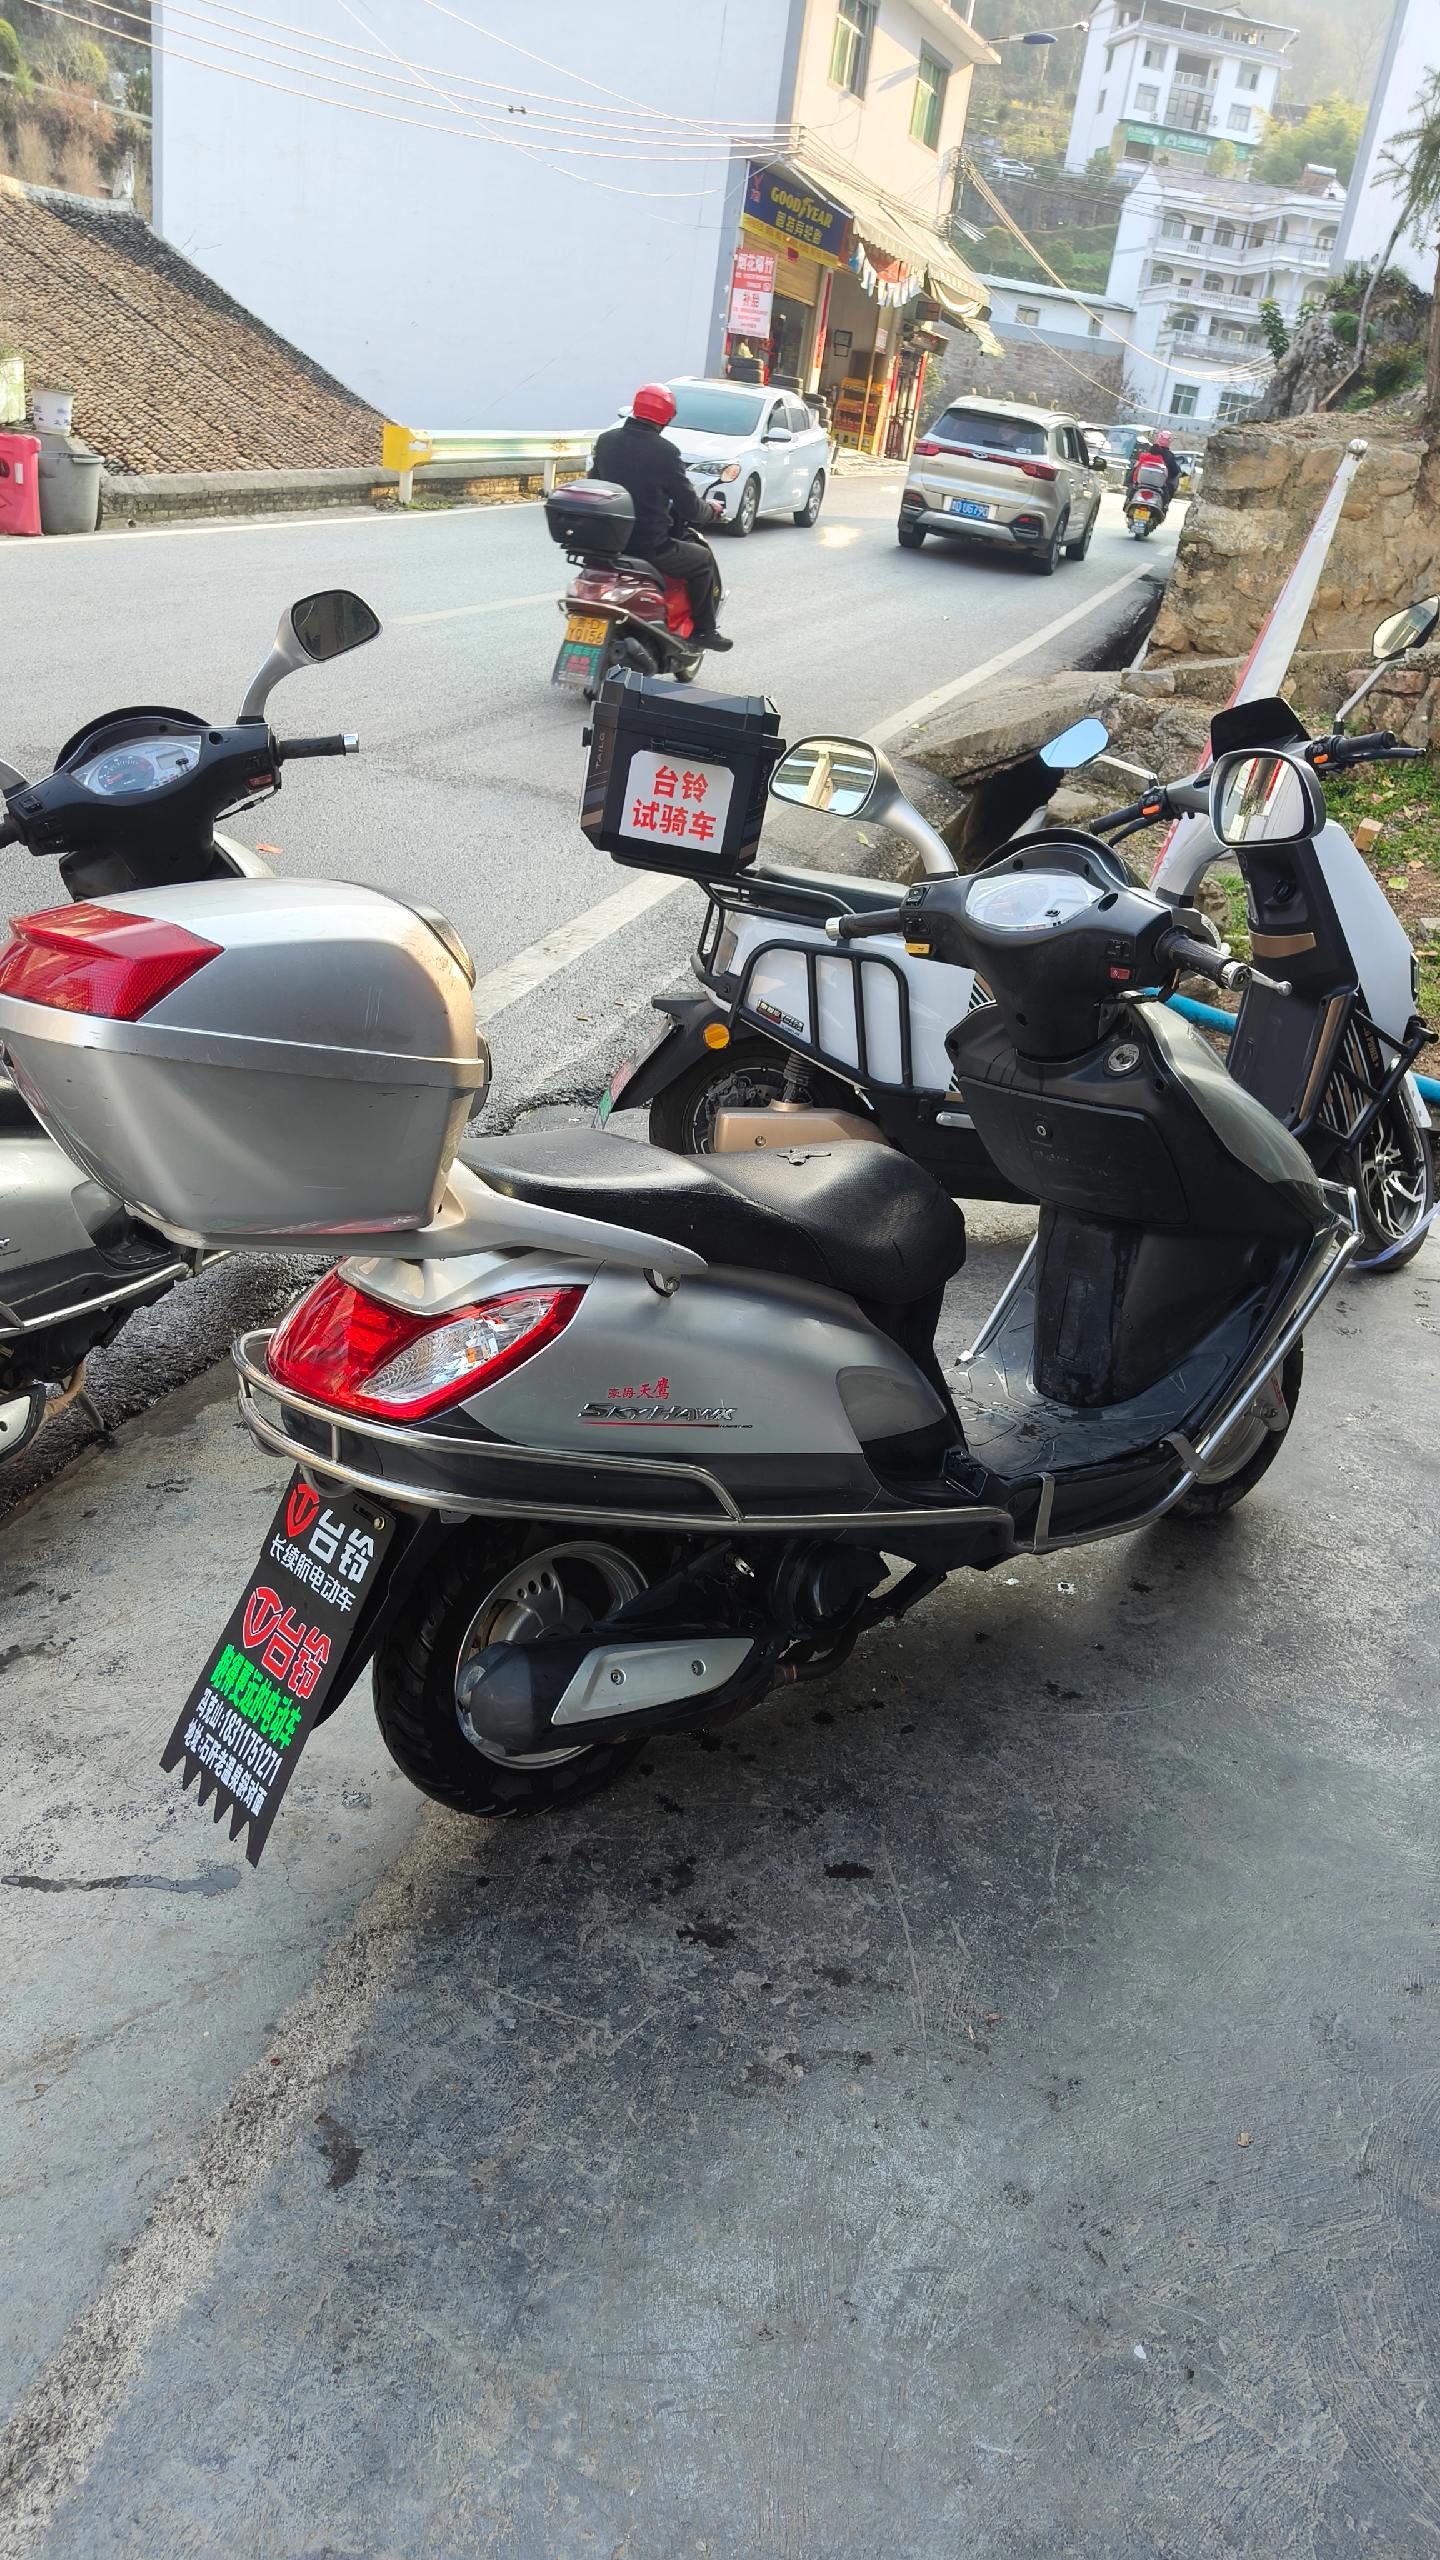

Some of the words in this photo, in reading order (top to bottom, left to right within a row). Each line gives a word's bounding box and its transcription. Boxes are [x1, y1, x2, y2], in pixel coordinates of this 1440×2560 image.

[770, 186, 833, 228] GOODYEAR
[653, 765, 709, 804] 台铃
[632, 798, 717, 842] 试骑车
[268, 1532, 357, 1613] 长续航电动车
[308, 1508, 375, 1584] 台铃
[261, 1607, 332, 1701] 台铃
